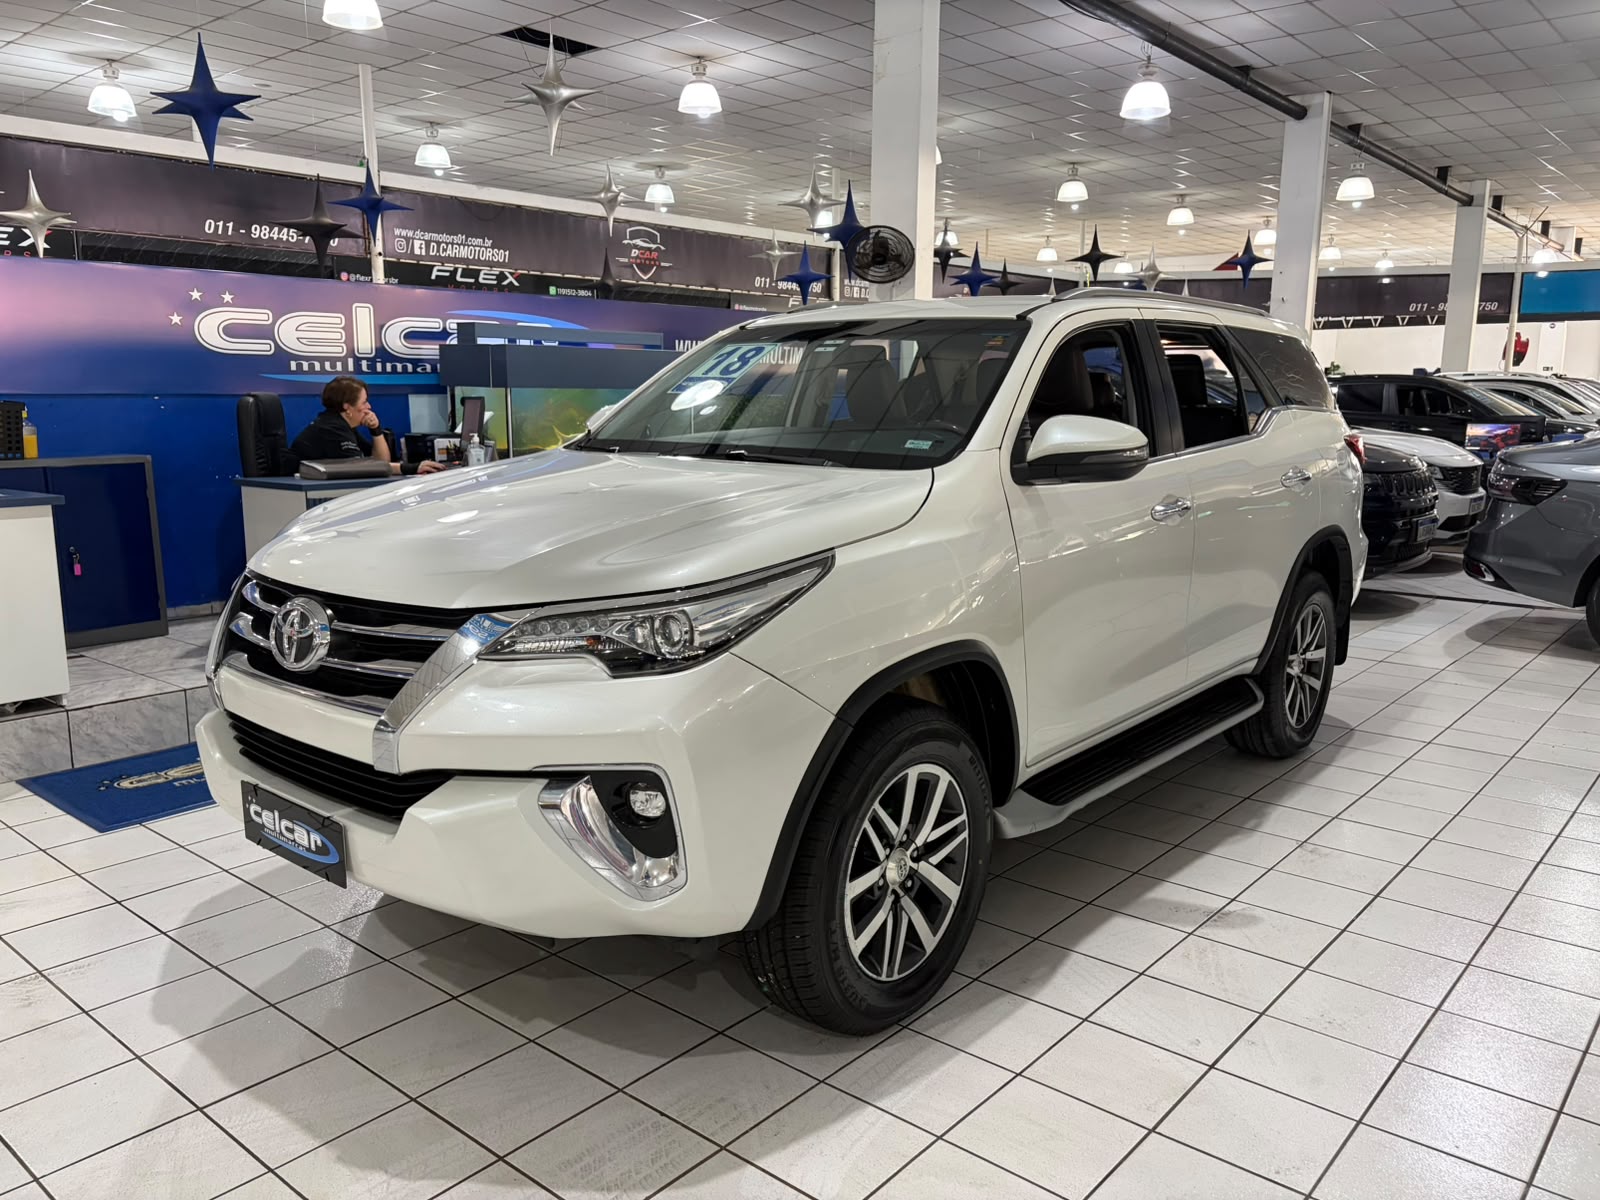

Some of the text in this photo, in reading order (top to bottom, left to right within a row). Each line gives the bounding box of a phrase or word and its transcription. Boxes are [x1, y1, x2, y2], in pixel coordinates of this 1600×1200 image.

[204, 219, 234, 236] 011
[394, 227, 493, 248] www.dcarmotors01.com.br
[429, 243, 510, 263] D.CARMOTORS01
[431, 265, 521, 287] FLEX
[754, 276, 771, 289] 011
[1408, 302, 1429, 312] 011
[290, 358, 439, 373] multima
[702, 346, 766, 377] 18
[249, 803, 323, 852] celcar
